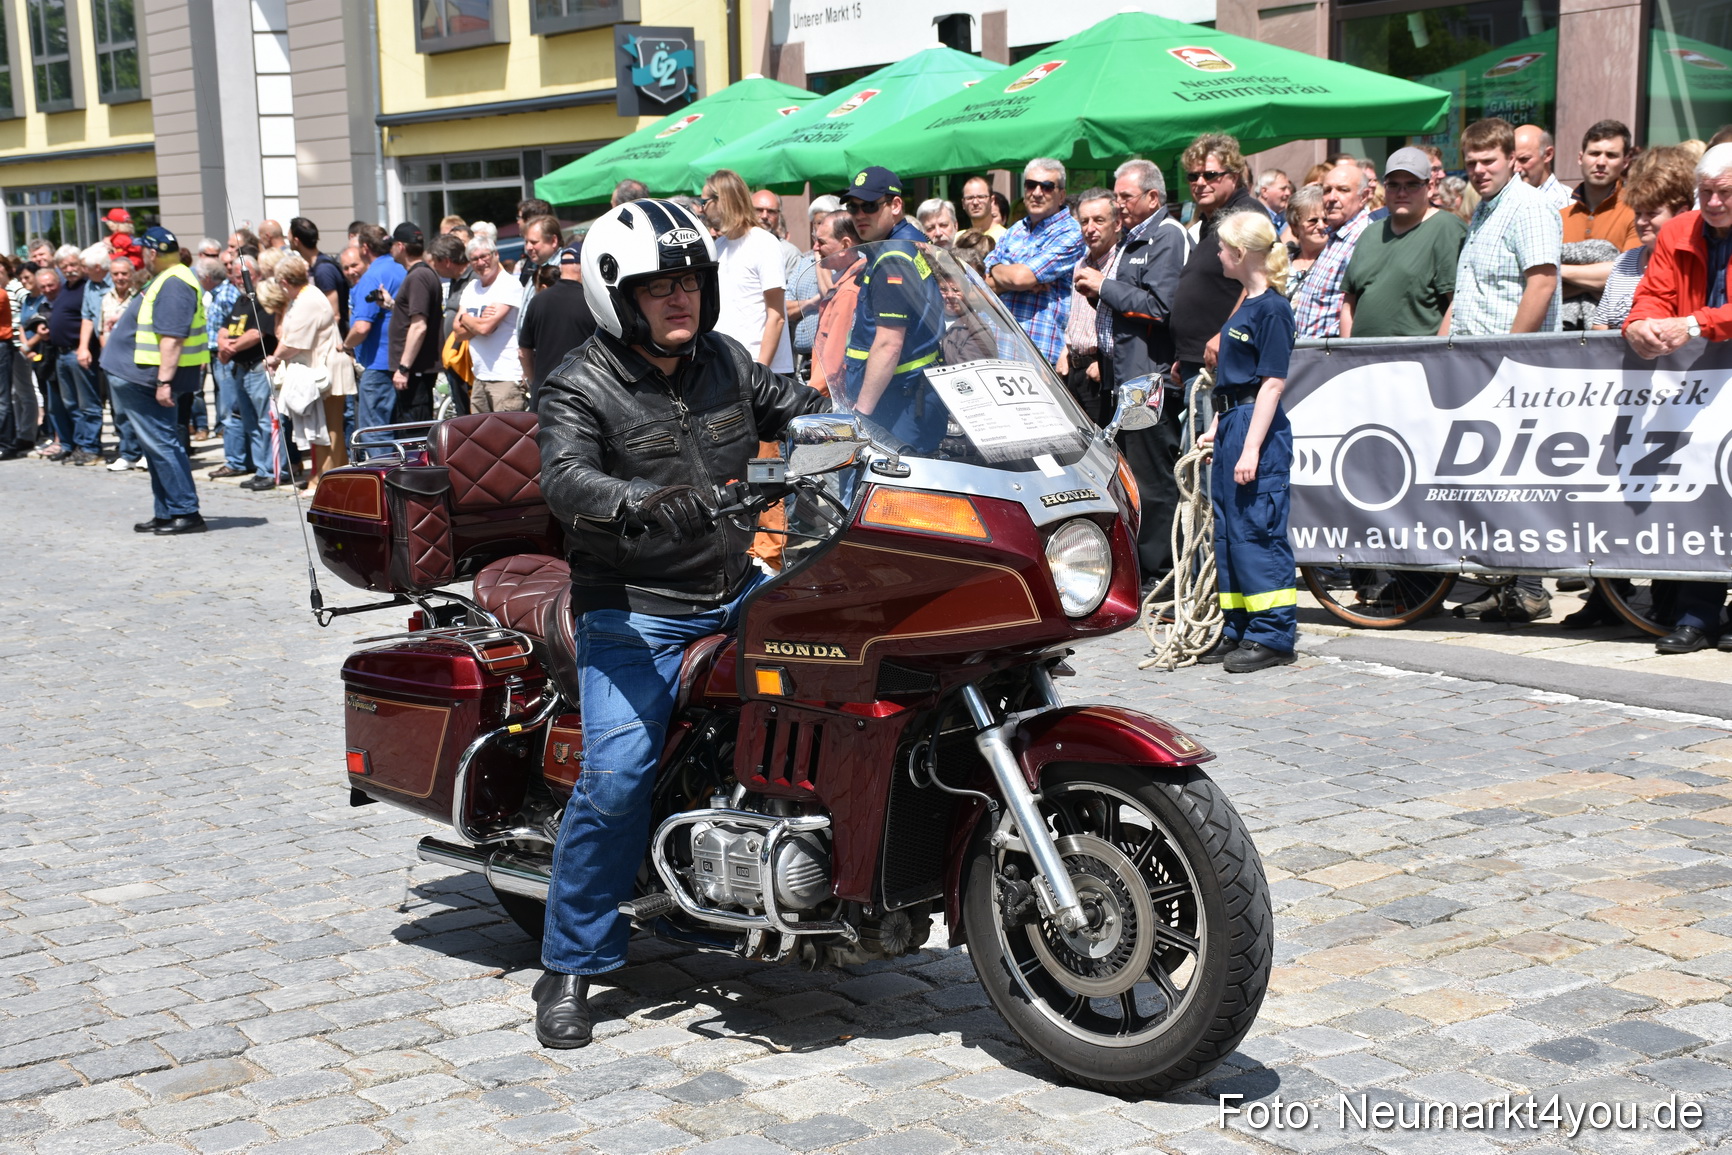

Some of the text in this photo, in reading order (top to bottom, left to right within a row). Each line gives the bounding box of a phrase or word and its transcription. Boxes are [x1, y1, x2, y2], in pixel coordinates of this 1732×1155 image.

[793, 2, 862, 29] Unterer Markt 15
[650, 50, 677, 87] G2
[1172, 84, 1332, 102] Lammsbräu
[1490, 99, 1535, 112] GARTEN
[995, 376, 1039, 396] 512
[1493, 379, 1710, 409] Autoklassik
[1434, 415, 1694, 478] Dietz
[1041, 489, 1100, 507] HONDA
[1424, 488, 1562, 503] BREITENBRUNN
[1292, 519, 1732, 556] ww.autoklassik-diet
[763, 640, 847, 658] HONDA
